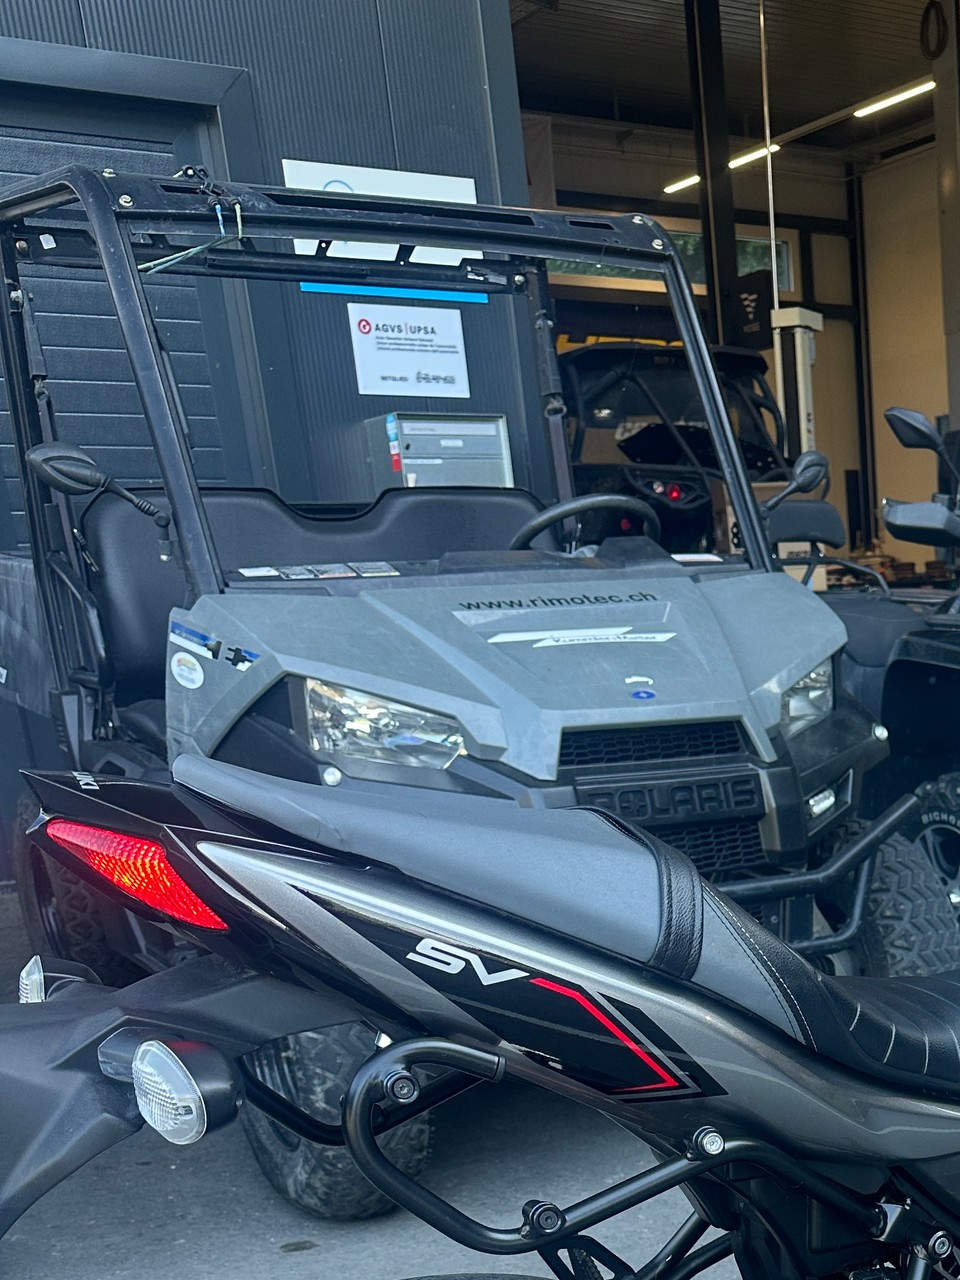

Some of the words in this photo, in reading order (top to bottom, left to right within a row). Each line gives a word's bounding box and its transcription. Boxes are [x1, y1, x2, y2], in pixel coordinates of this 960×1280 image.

[374, 323, 403, 333] AGVS
[409, 325, 437, 335] UPSA
[459, 591, 657, 610] www.rimotec.ch
[587, 779, 759, 820] POLARIS
[406, 938, 530, 986] SV
